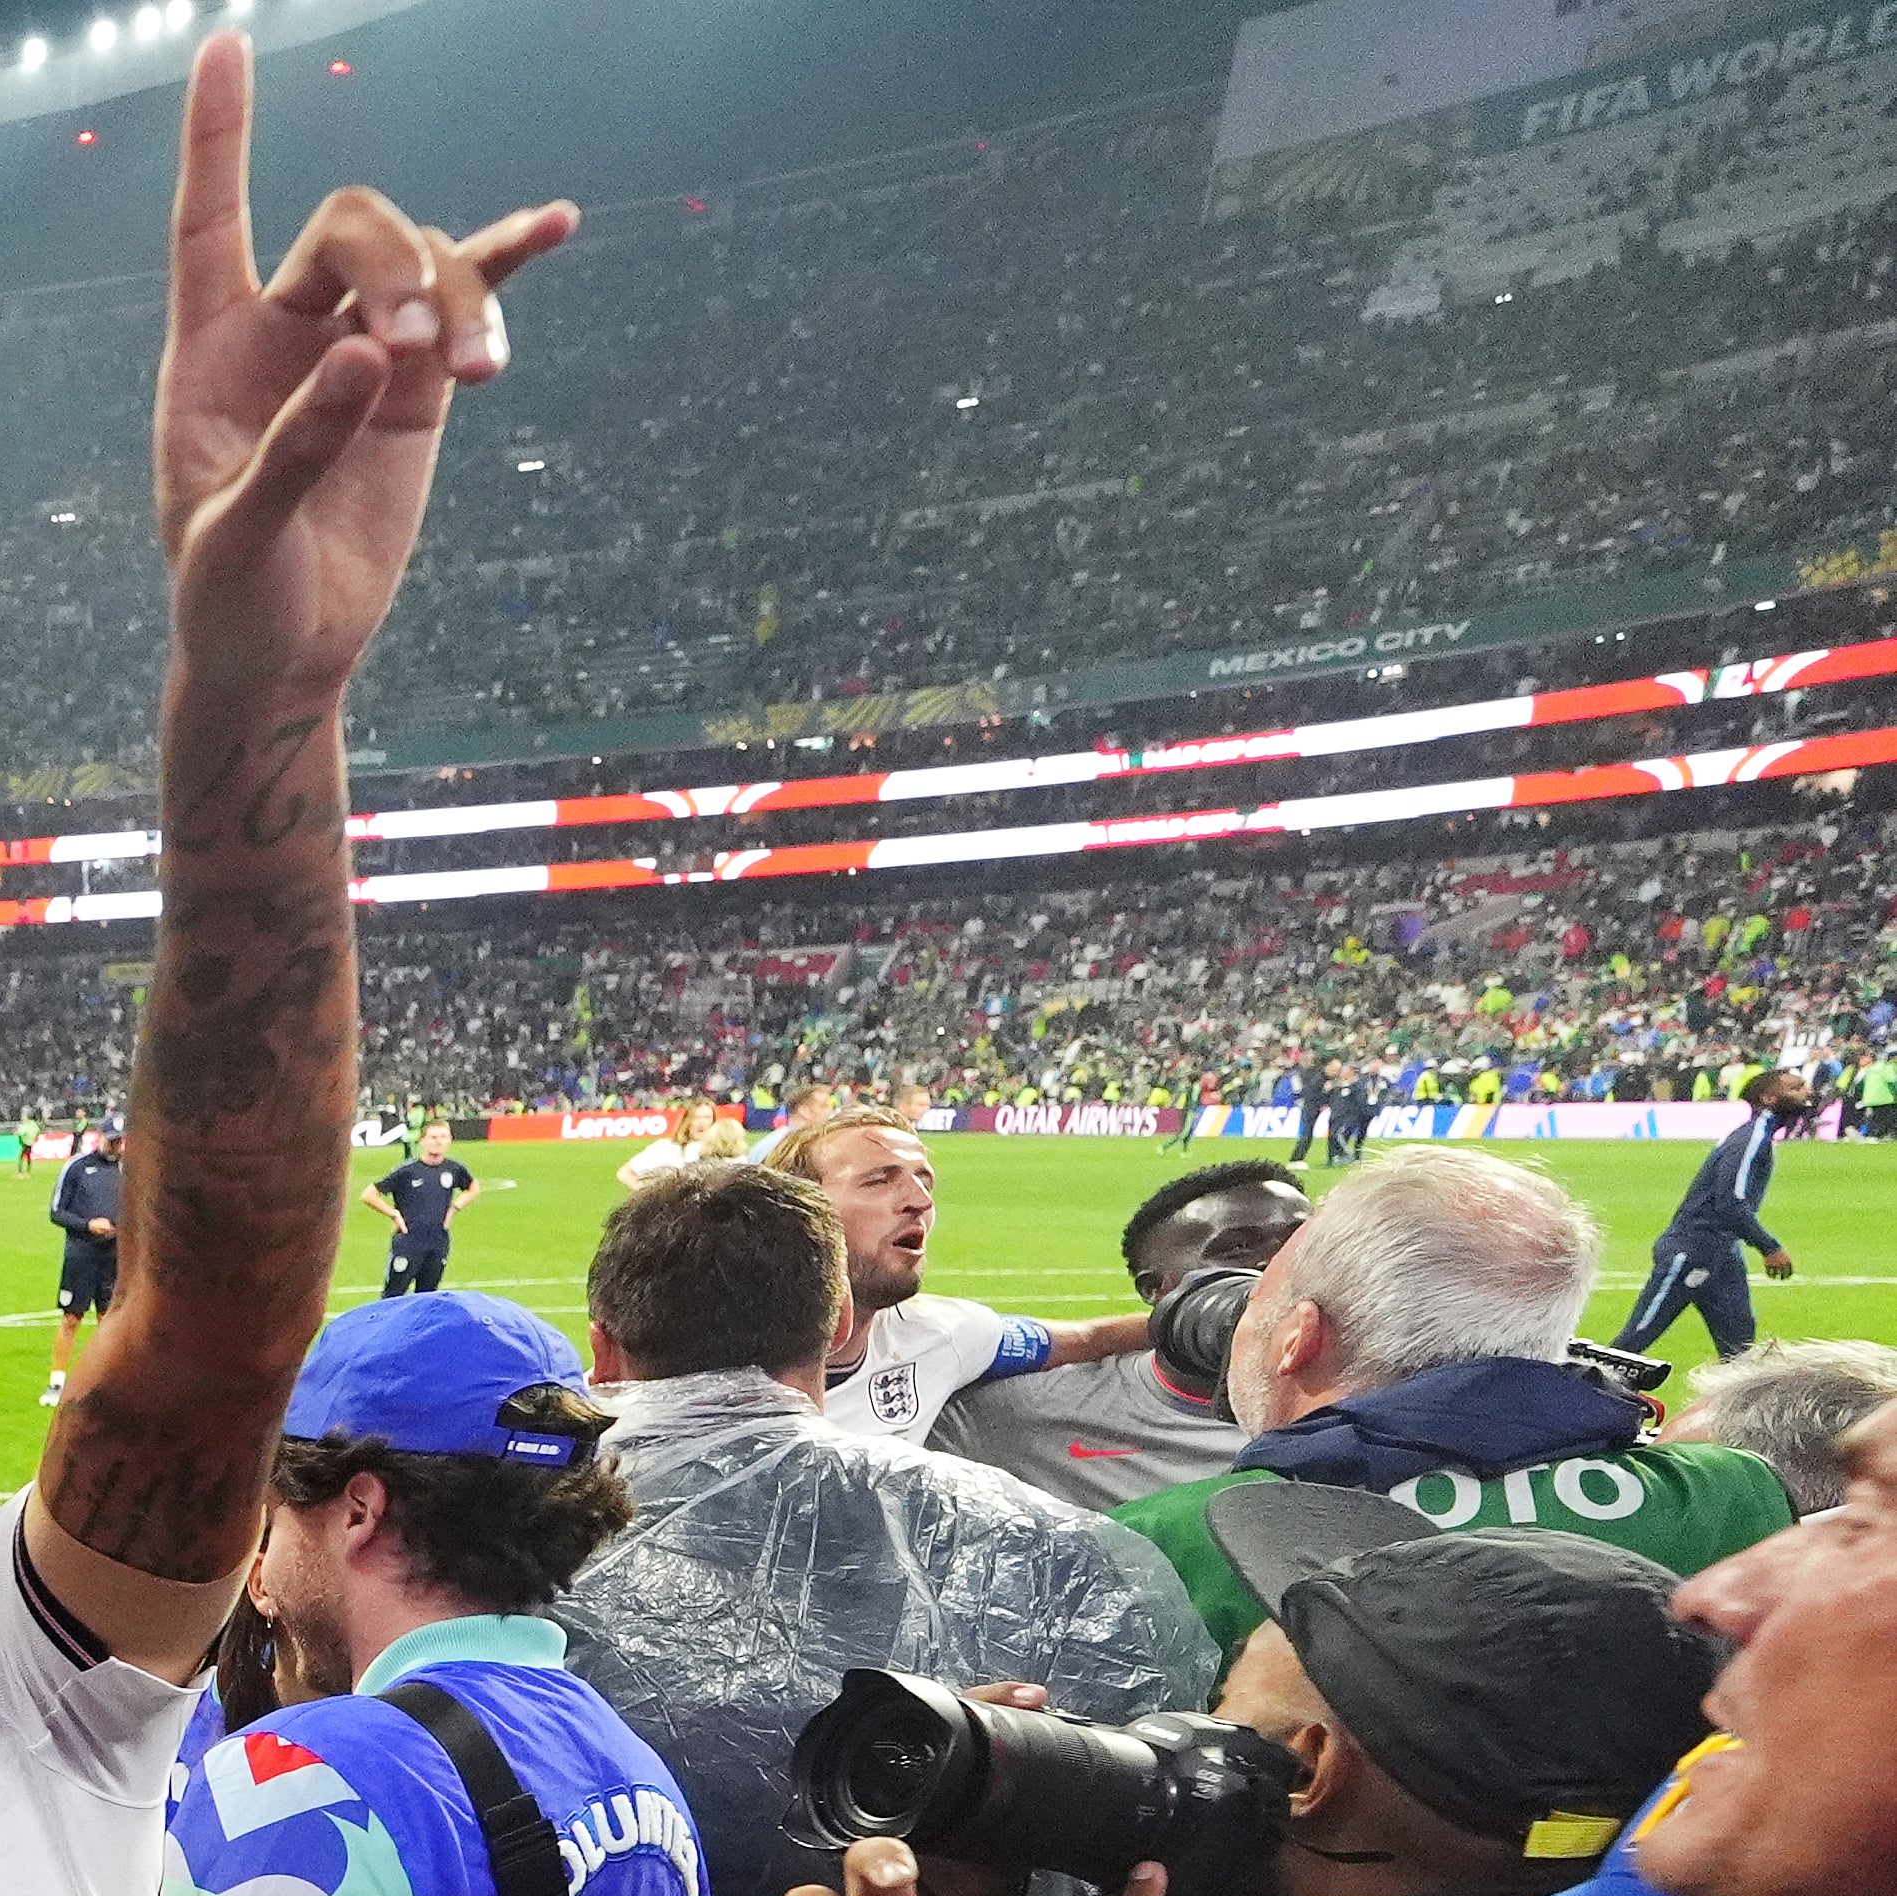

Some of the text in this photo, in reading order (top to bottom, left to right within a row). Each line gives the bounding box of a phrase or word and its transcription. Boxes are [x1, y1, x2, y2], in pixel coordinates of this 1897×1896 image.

[1522, 75, 1650, 141] FIFA
[1209, 637, 1367, 678] MEXICO
[561, 1113, 668, 1139] Lenovo
[995, 1104, 1160, 1137] QATAR AIRWAYS
